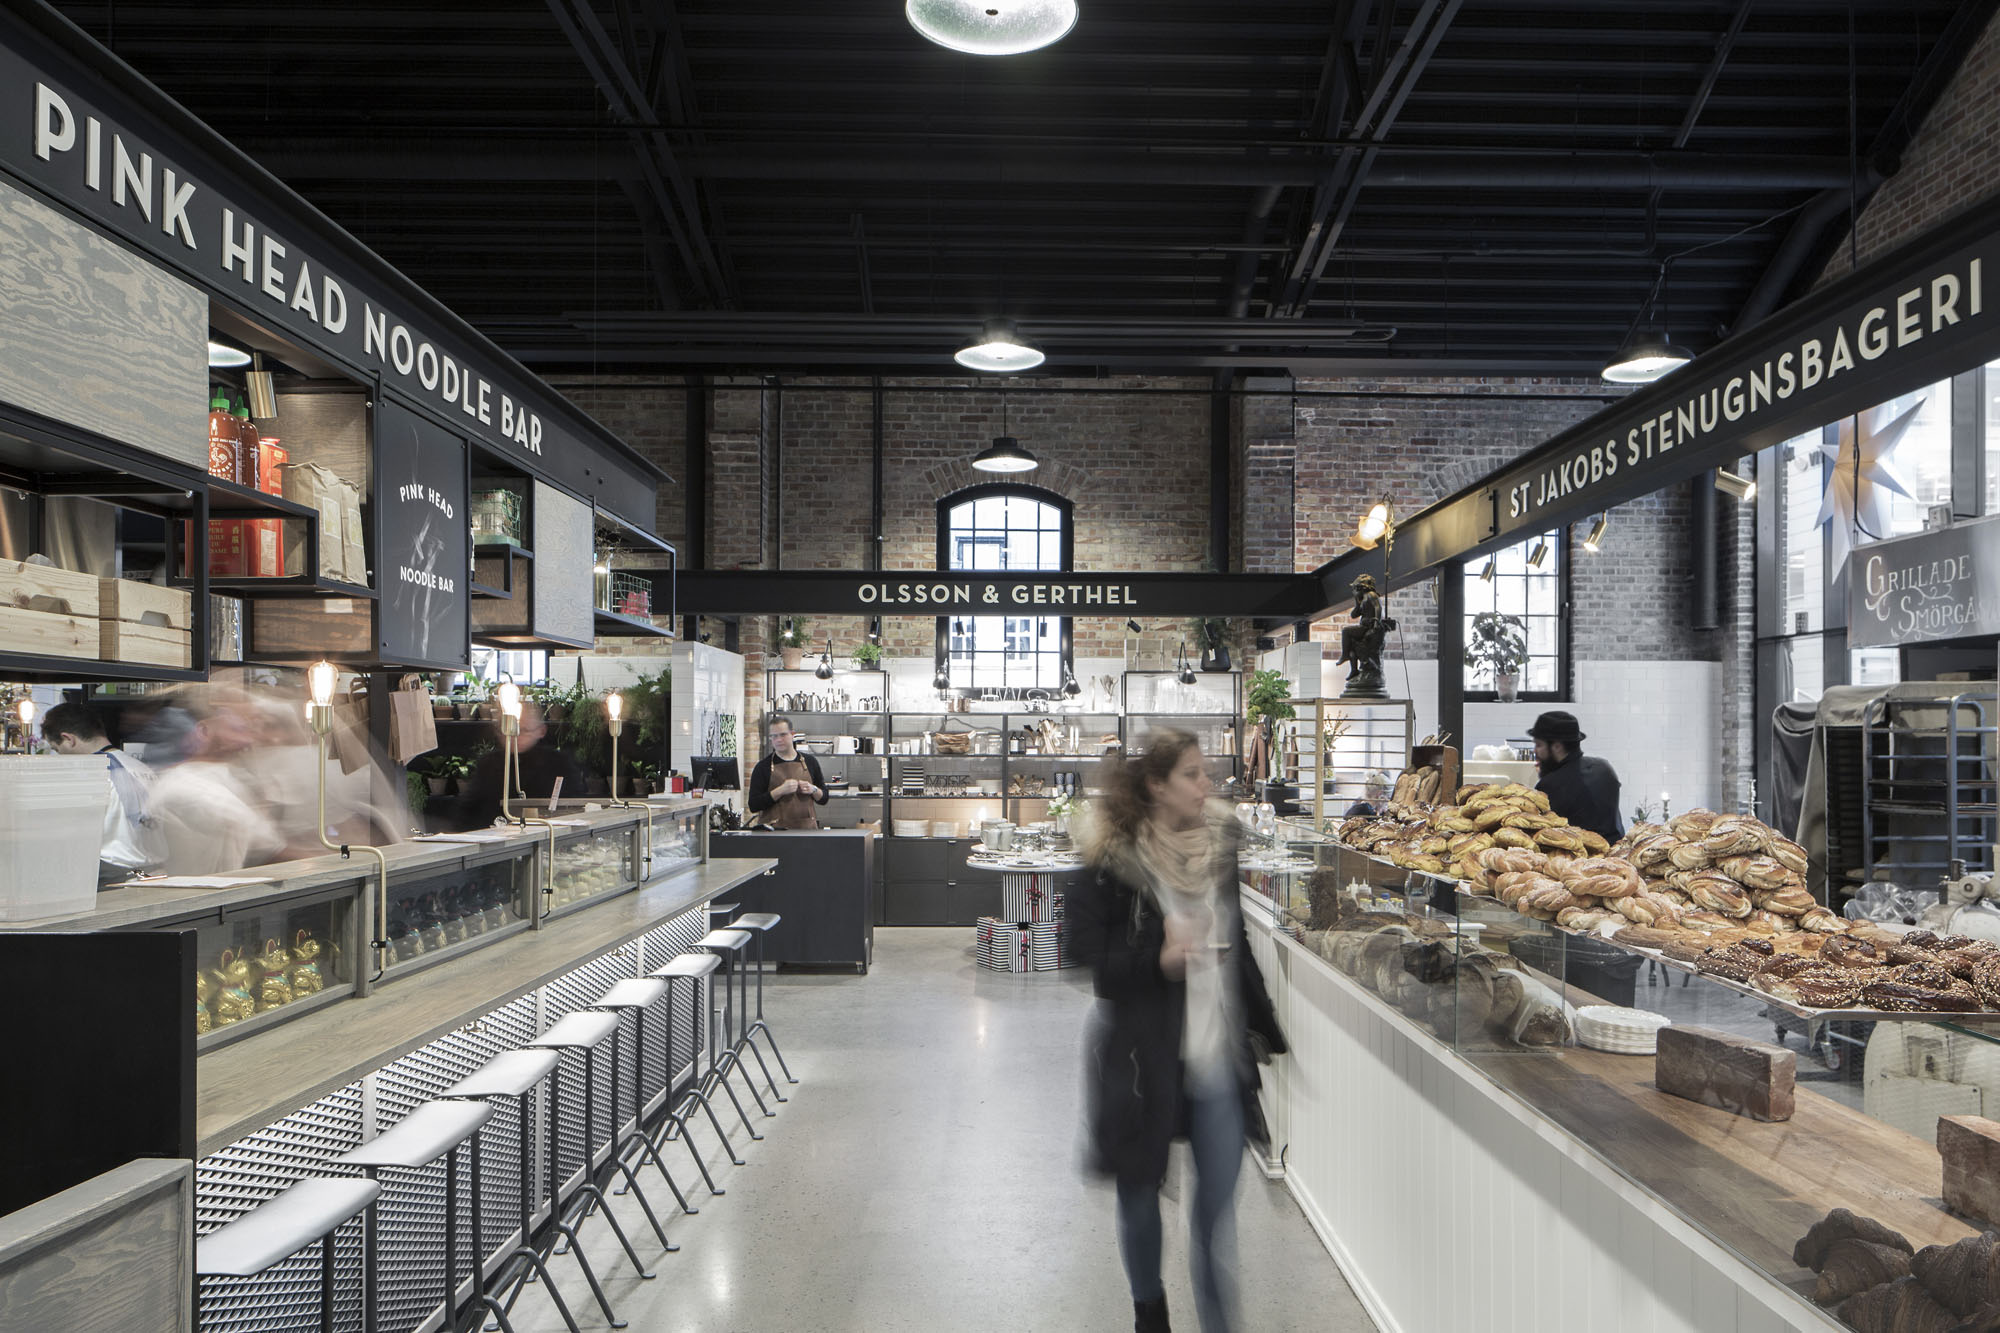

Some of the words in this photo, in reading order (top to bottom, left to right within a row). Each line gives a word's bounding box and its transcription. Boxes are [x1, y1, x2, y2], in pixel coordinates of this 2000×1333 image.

[35, 82, 198, 249] PINK
[222, 208, 348, 334] HEAD
[364, 303, 491, 426] NOODLE
[501, 394, 542, 456] BAR
[1510, 481, 1530, 518] ST
[1537, 440, 1618, 507] JAKOBS
[1627, 258, 1982, 466] STENUGNSBAGERI
[400, 484, 424, 502] PINK
[428, 487, 454, 519] HEAD
[400, 566, 436, 589] NOODLE
[438, 576, 454, 593] BAR
[858, 584, 970, 605] OLSSON
[982, 584, 999, 605] &
[1011, 584, 1137, 605] GERTHEL
